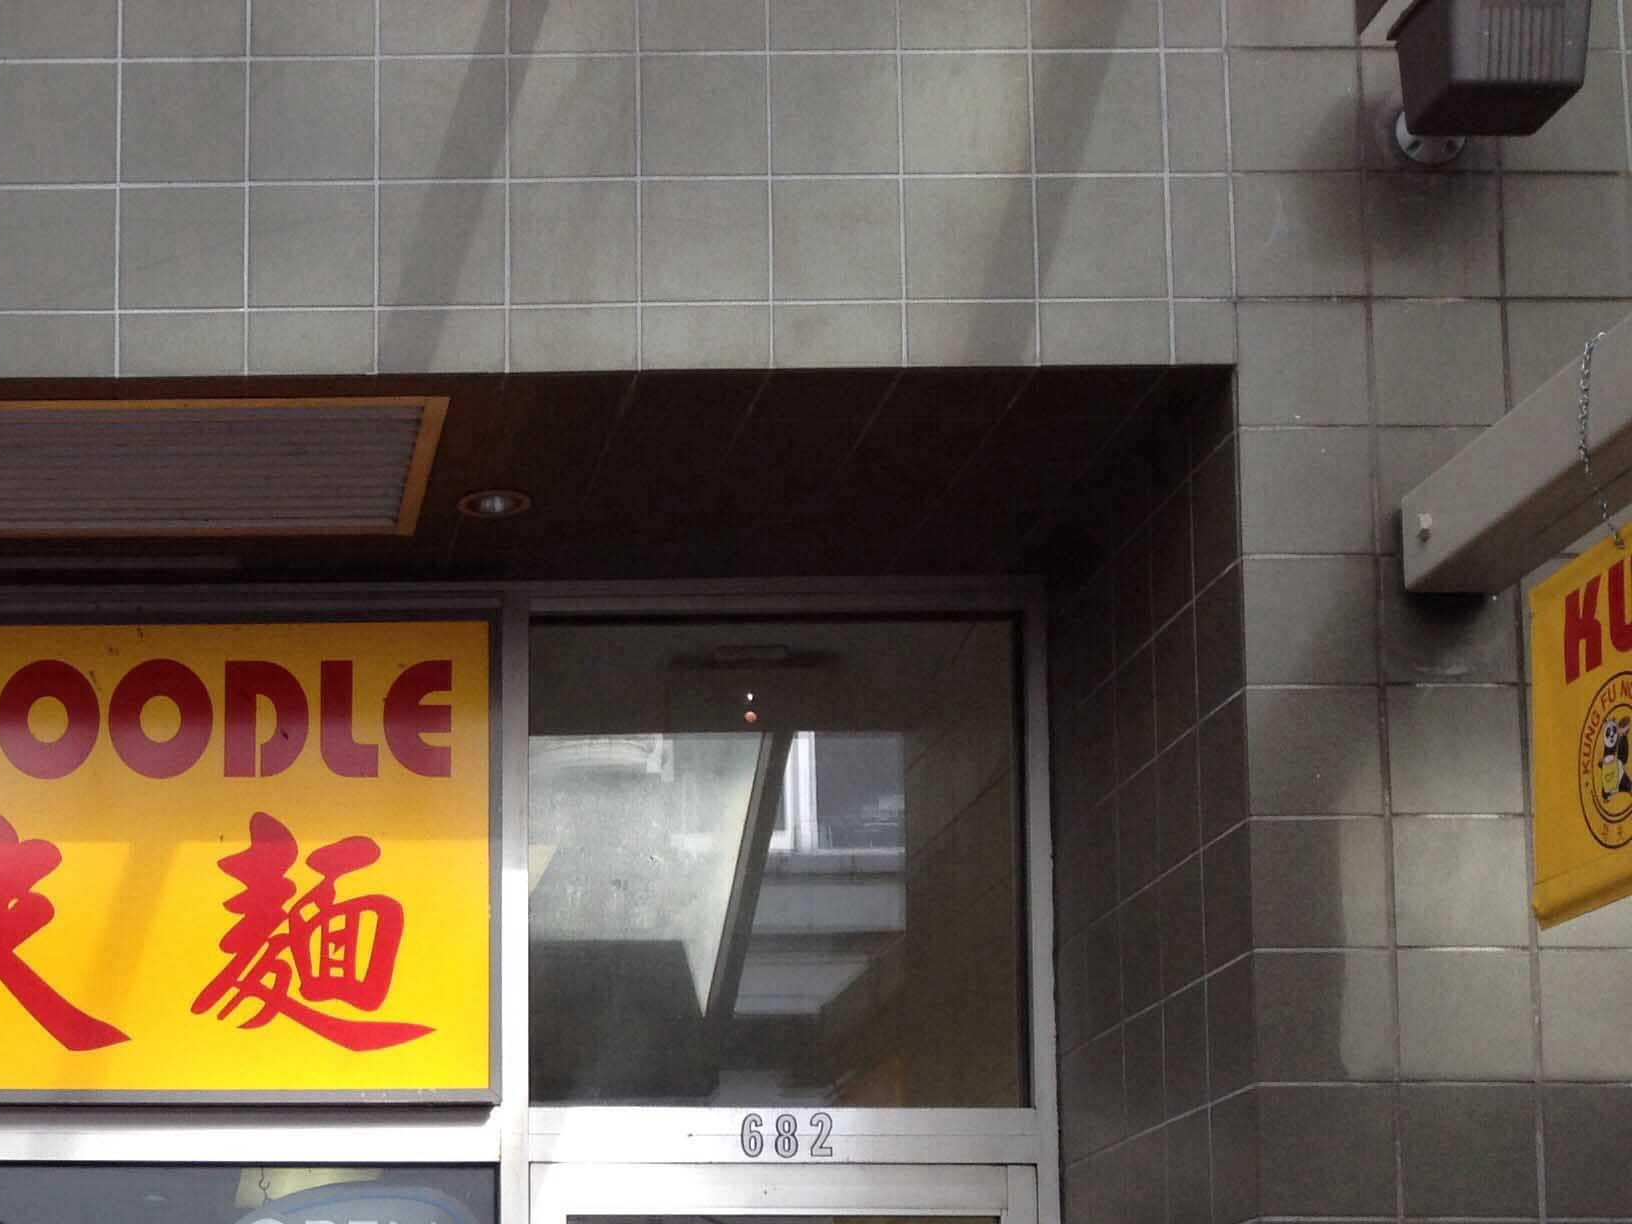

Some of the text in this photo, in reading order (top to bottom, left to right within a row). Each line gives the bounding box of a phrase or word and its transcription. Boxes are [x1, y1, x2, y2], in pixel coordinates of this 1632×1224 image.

[1582, 710, 1601, 774] KUNG
[1601, 684, 1617, 710] FU
[740, 1111, 833, 1158] 682
